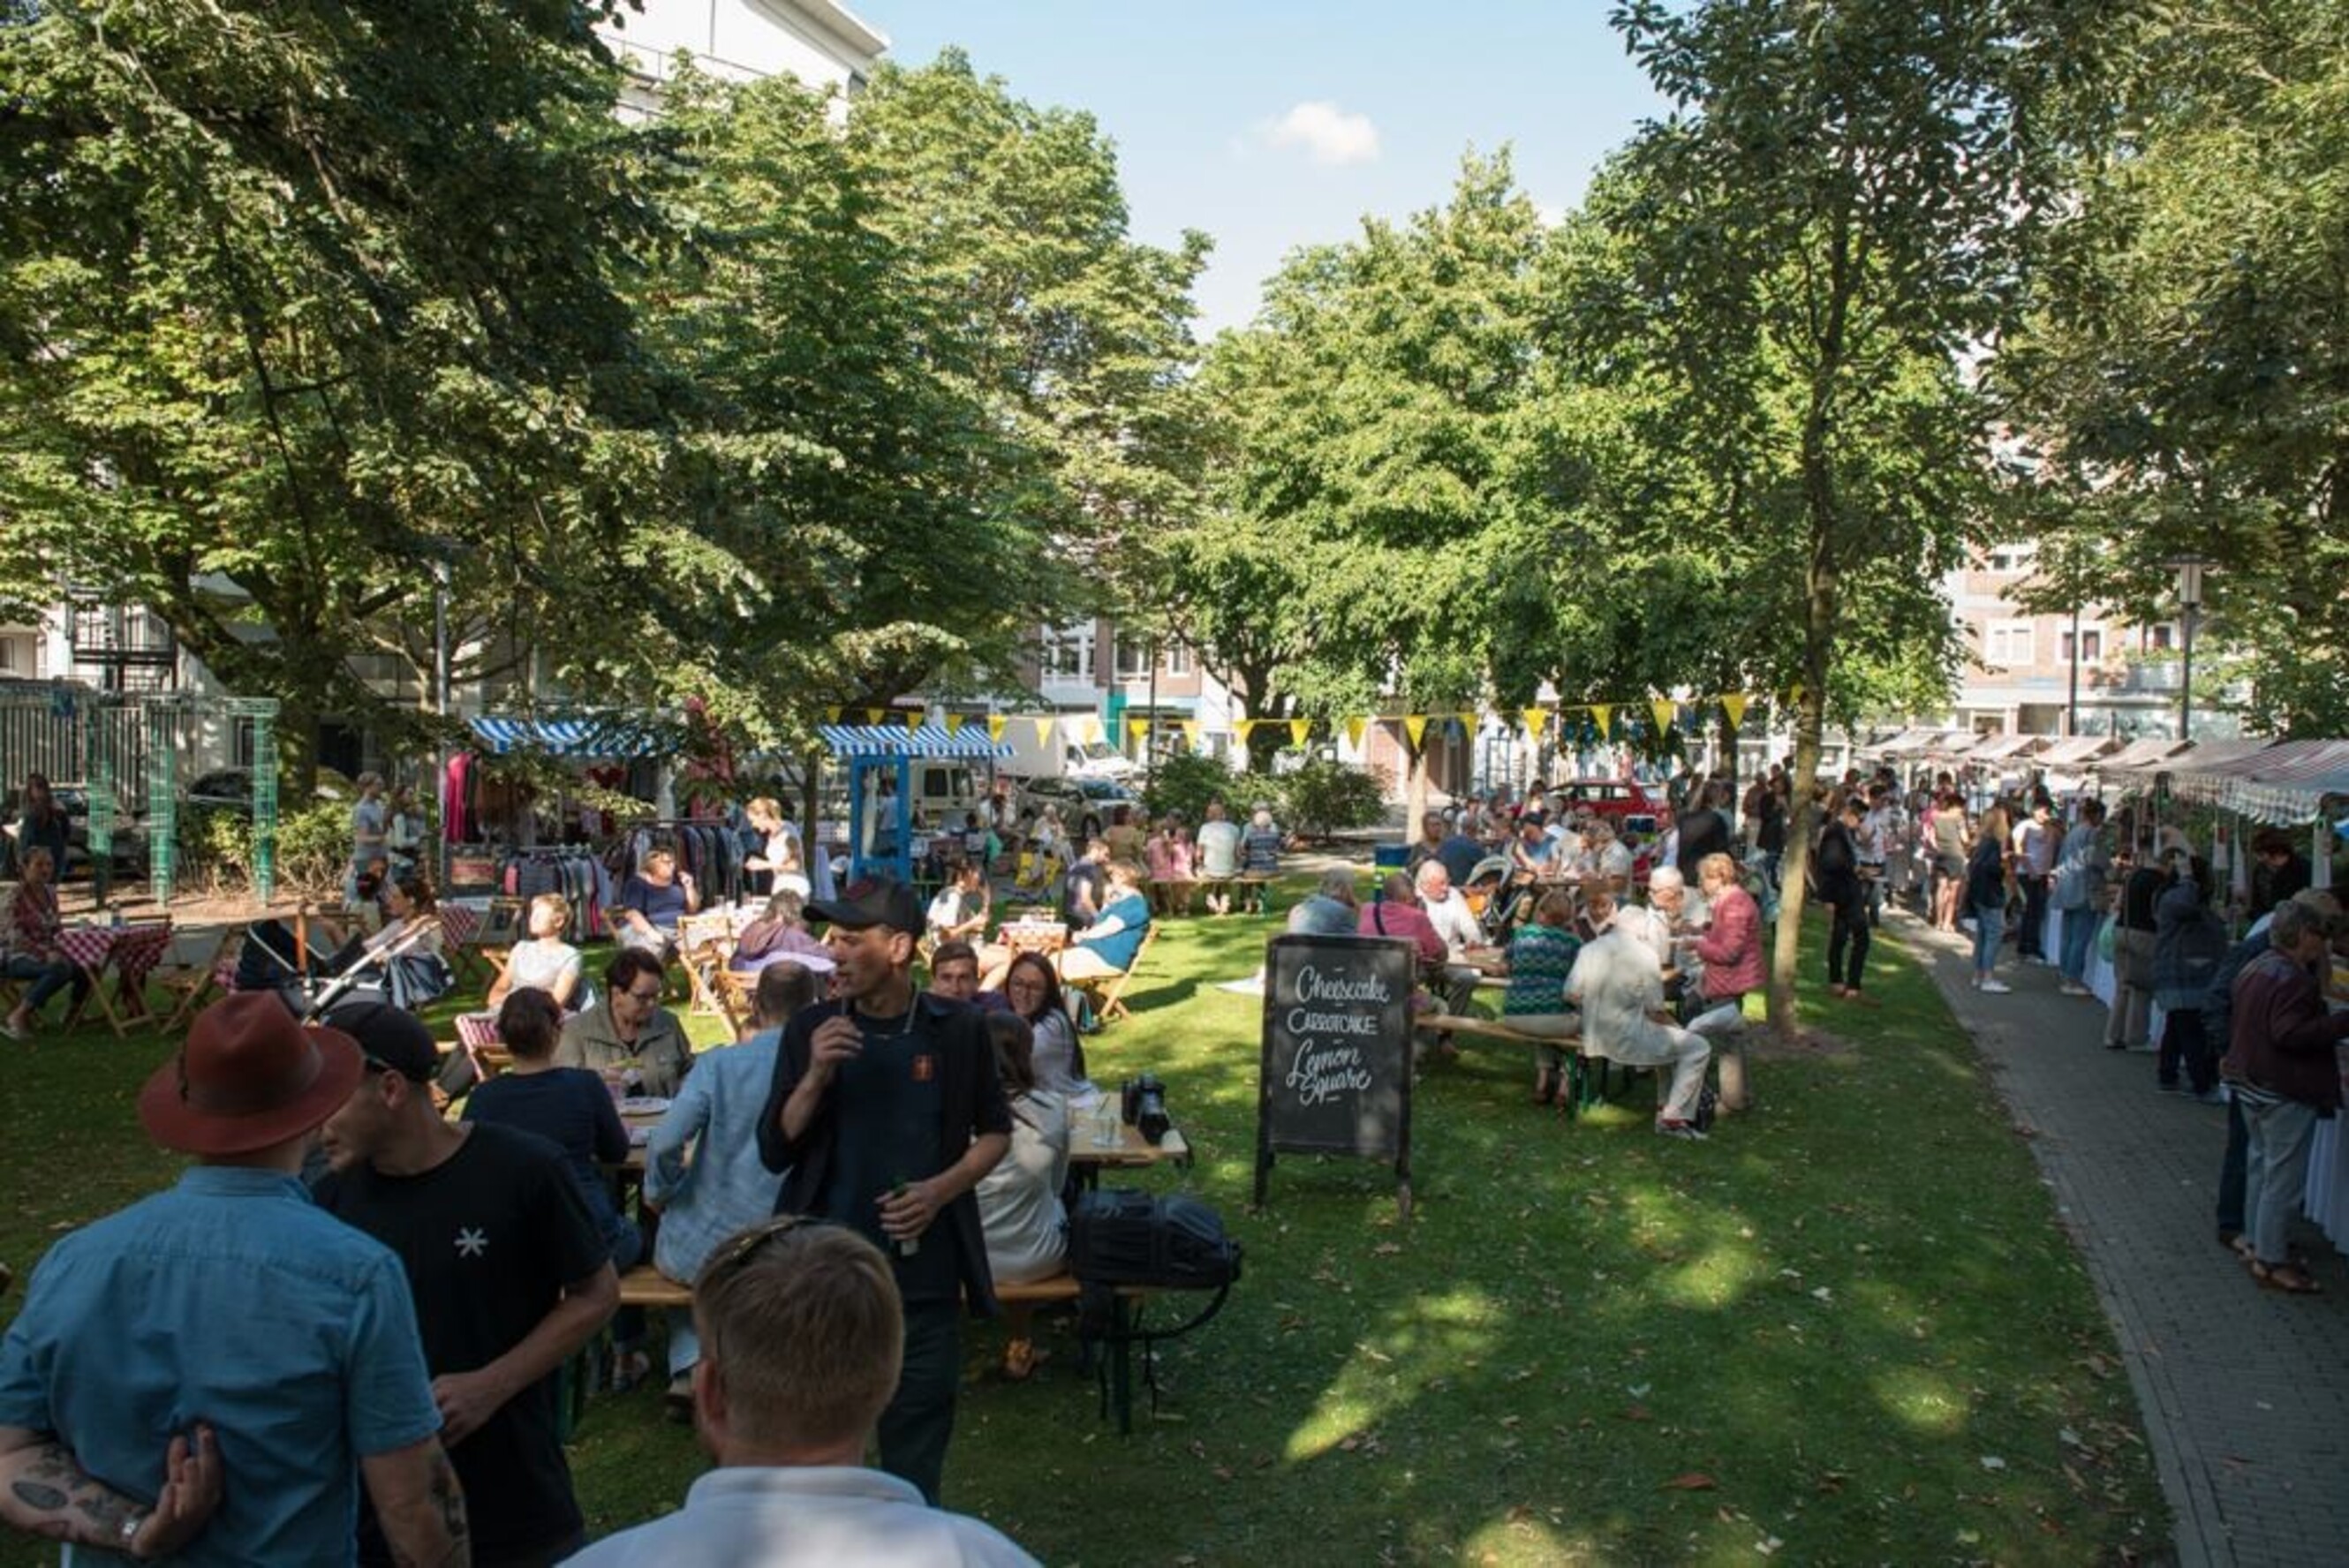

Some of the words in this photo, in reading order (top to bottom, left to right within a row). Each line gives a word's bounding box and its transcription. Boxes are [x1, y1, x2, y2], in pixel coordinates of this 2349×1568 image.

[1295, 965, 1390, 1003] Cheesecake
[1286, 1038, 1361, 1088] Lemon
[1300, 1067, 1371, 1106] Square
